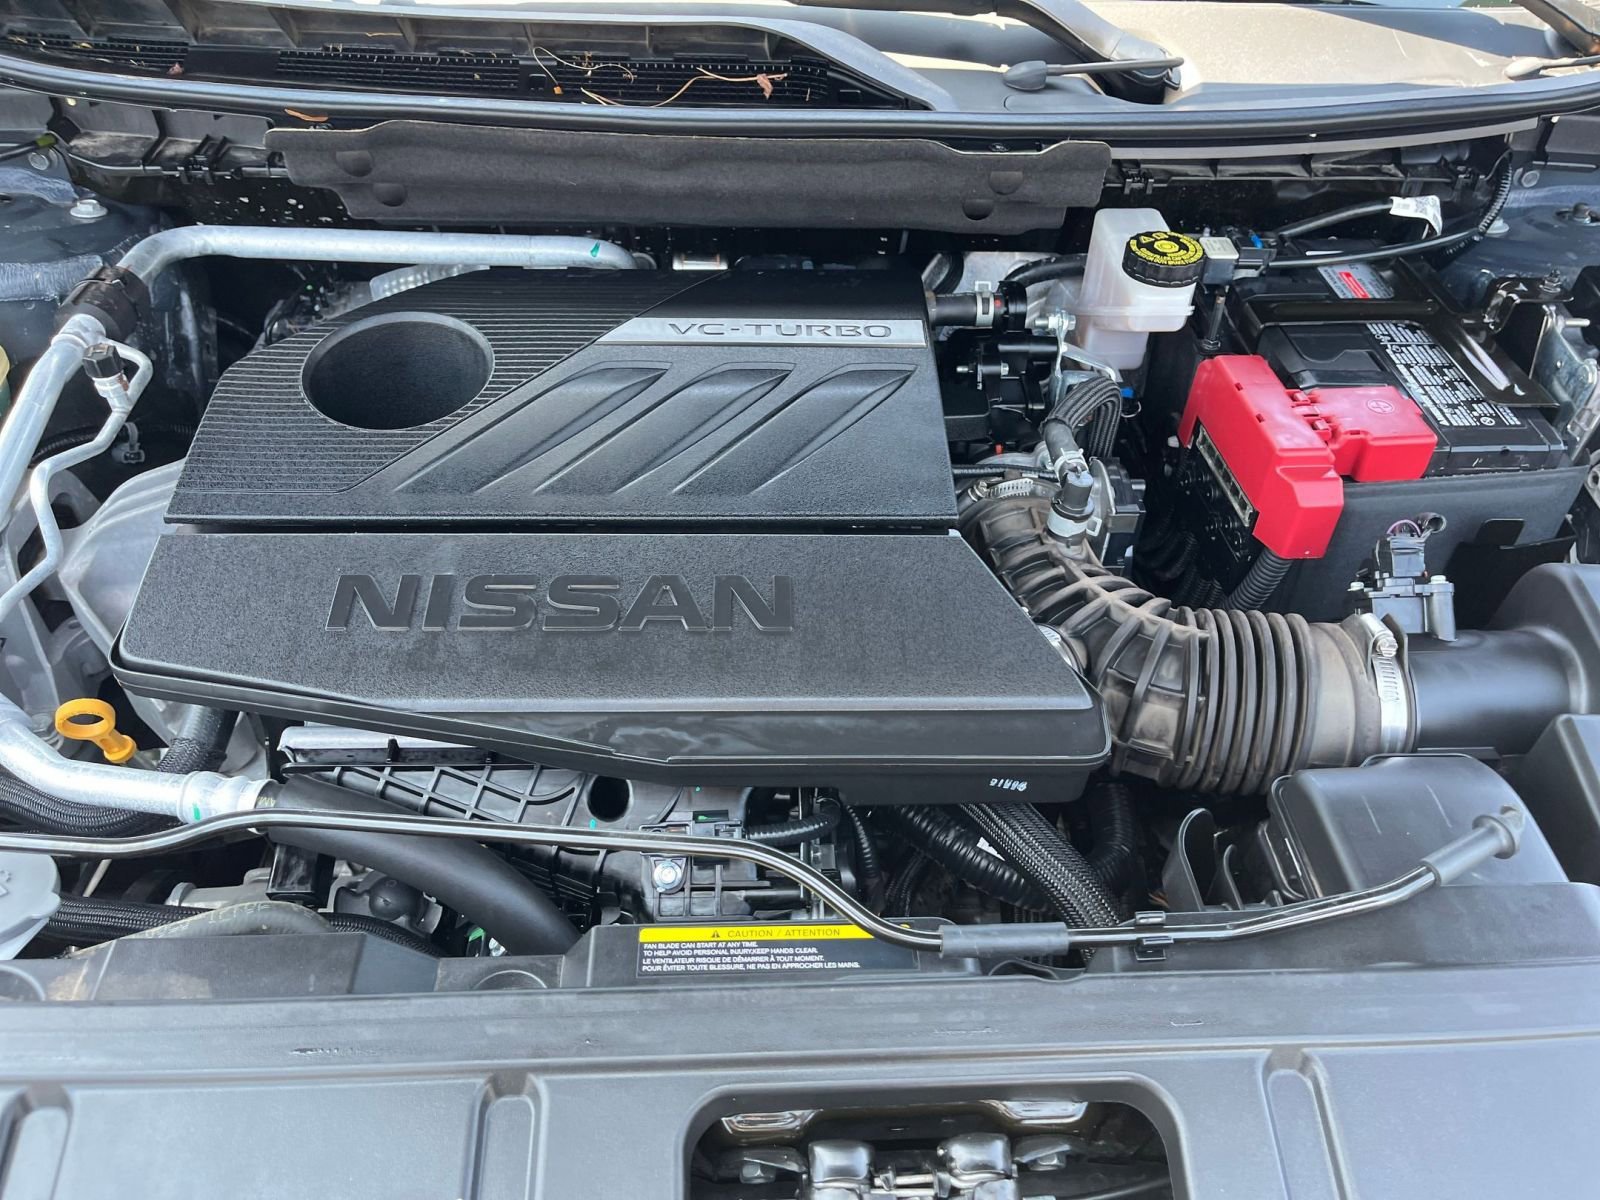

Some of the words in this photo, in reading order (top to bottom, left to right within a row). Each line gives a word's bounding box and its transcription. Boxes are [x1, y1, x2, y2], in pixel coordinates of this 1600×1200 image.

[668, 323, 892, 338] VC-TURBO
[325, 573, 794, 632] NISSAN
[727, 930, 773, 938] CAUTION
[785, 928, 840, 937] ATTENTION
[733, 955, 769, 963] DÉMARRER
[770, 954, 775, 962] À
